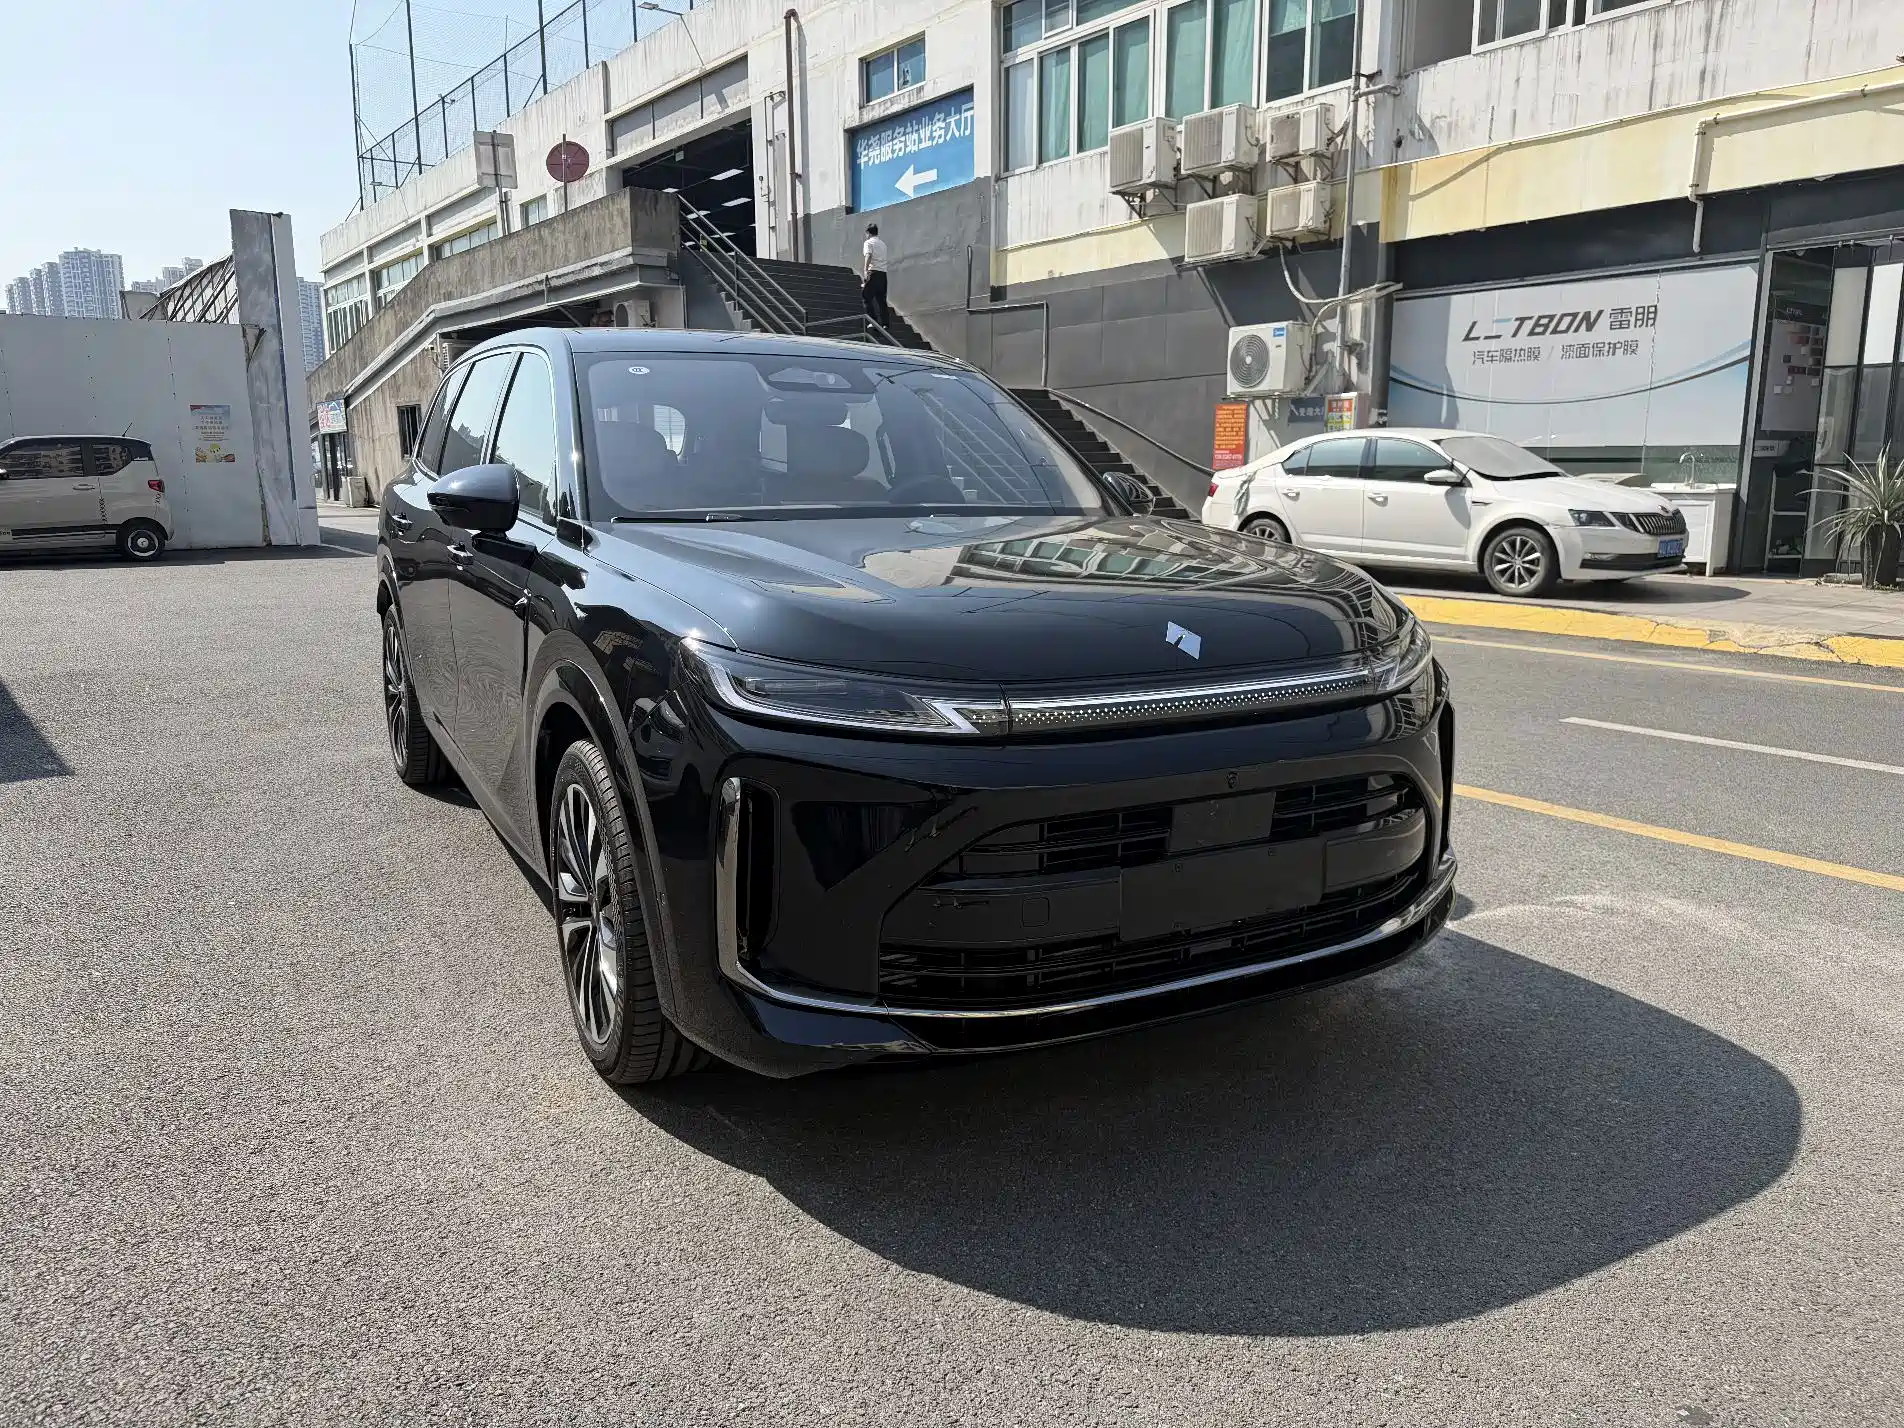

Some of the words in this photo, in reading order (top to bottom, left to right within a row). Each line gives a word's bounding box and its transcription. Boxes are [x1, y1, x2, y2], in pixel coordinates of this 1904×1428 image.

[1609, 304, 1658, 331] 雷朋
[1472, 346, 1541, 365] 汽车隔热膜
[1560, 339, 1640, 360] 漆面保护膜
